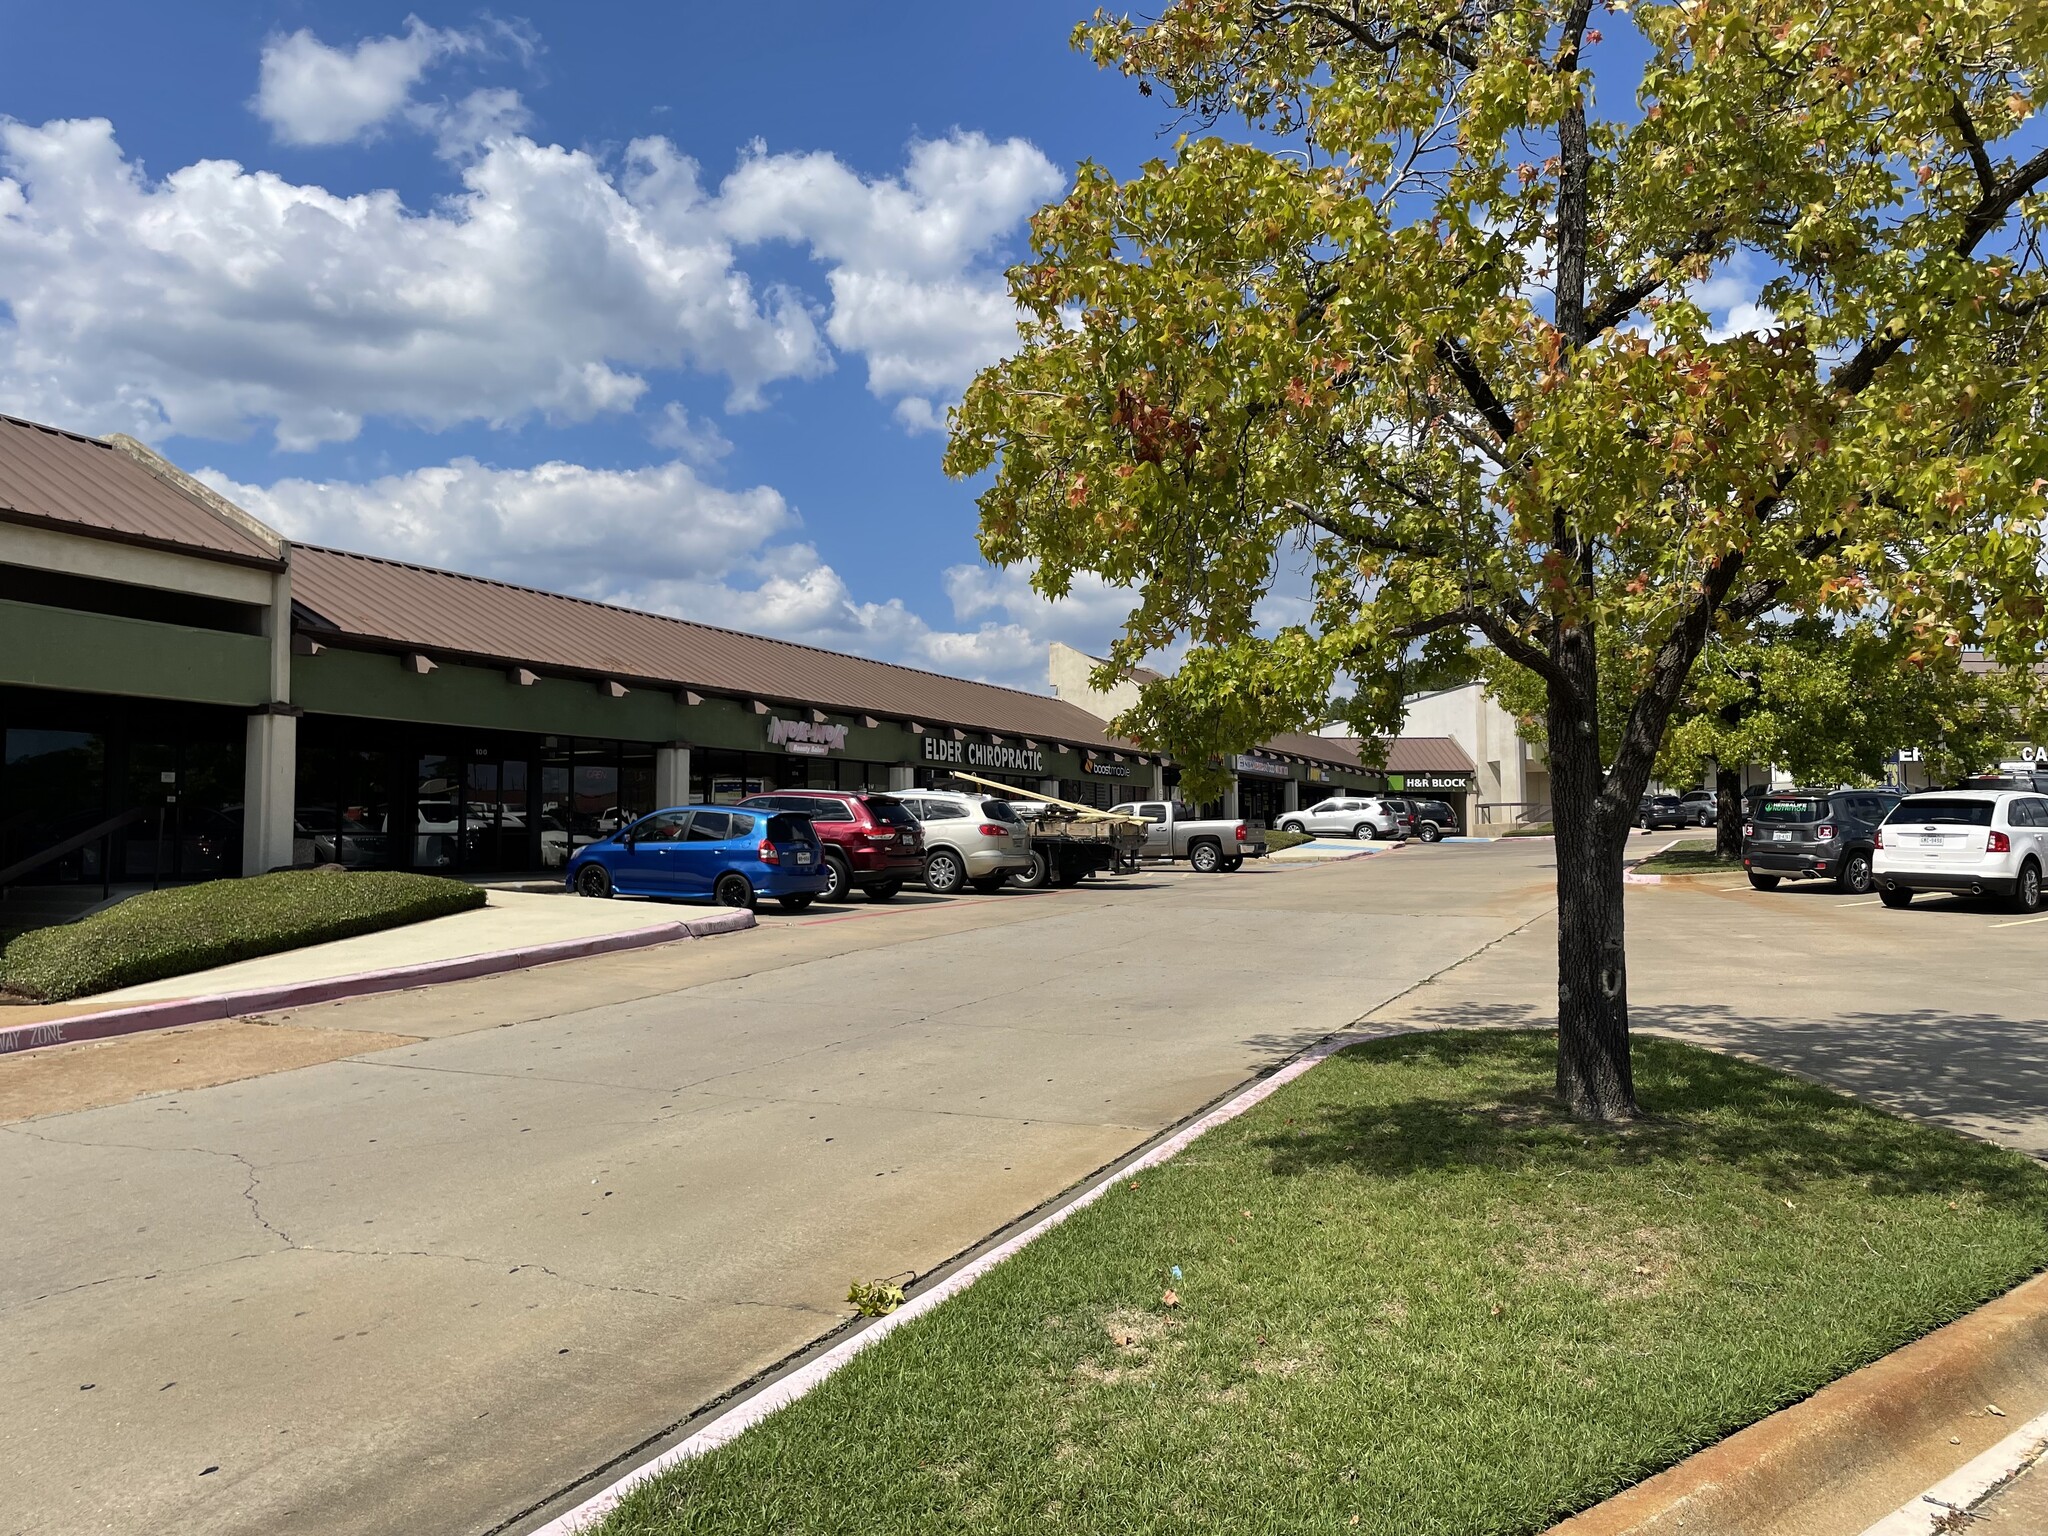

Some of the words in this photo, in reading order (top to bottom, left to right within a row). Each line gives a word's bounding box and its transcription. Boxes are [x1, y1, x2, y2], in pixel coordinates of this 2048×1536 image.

[925, 737, 963, 762] ELDER
[968, 743, 1043, 772] CHIROPRACTIC
[1406, 778, 1430, 788] H&R
[1432, 778, 1466, 788] BLOCK
[30, 1024, 67, 1045] ZONE
